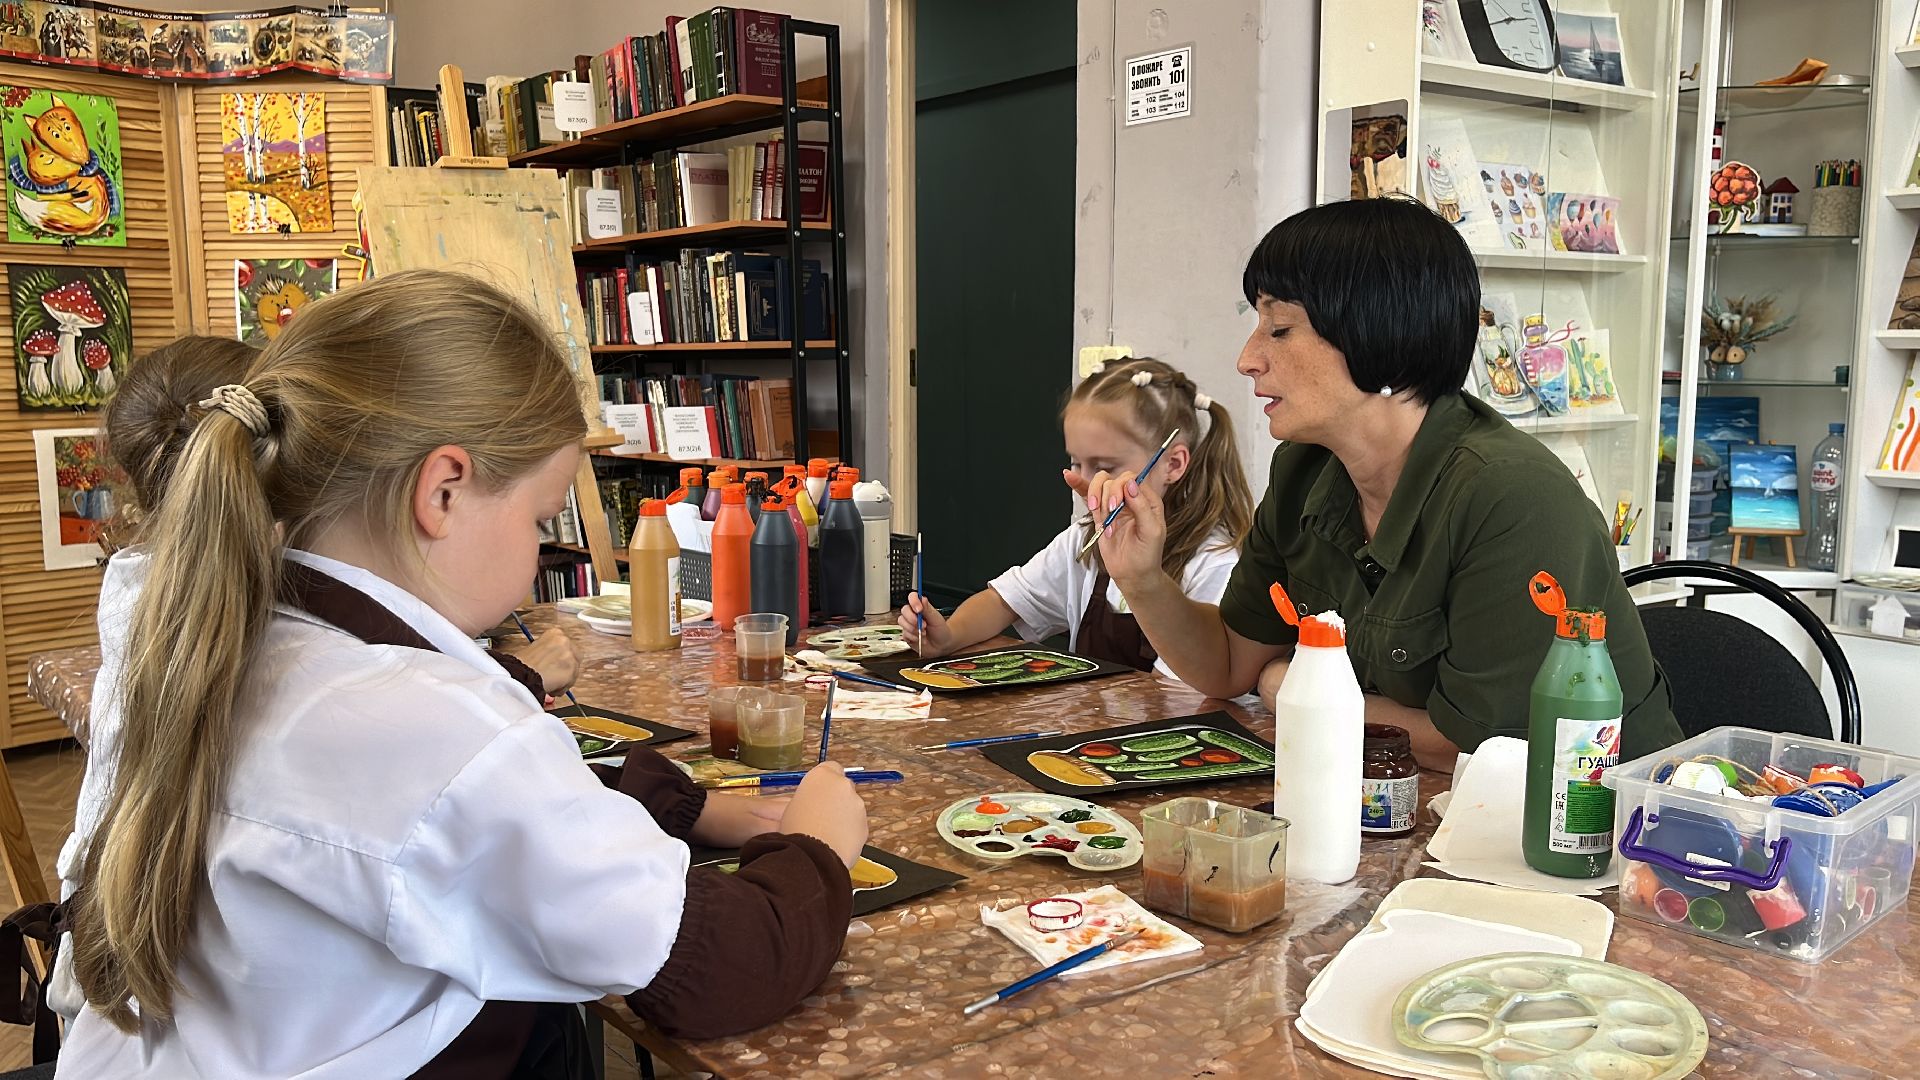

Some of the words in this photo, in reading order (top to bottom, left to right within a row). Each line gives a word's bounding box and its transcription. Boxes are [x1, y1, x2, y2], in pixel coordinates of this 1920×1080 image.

[108, 6, 133, 16] СРЕДНИЕ
[1131, 66, 1136, 76] О
[1137, 61, 1163, 75] ПОЖАРЕ
[1169, 69, 1185, 84] 101
[1131, 76, 1161, 90] ЗВОНИТЬ
[1174, 90, 1185, 99] 104
[1146, 106, 1157, 114] 103
[1174, 101, 1185, 109] 112
